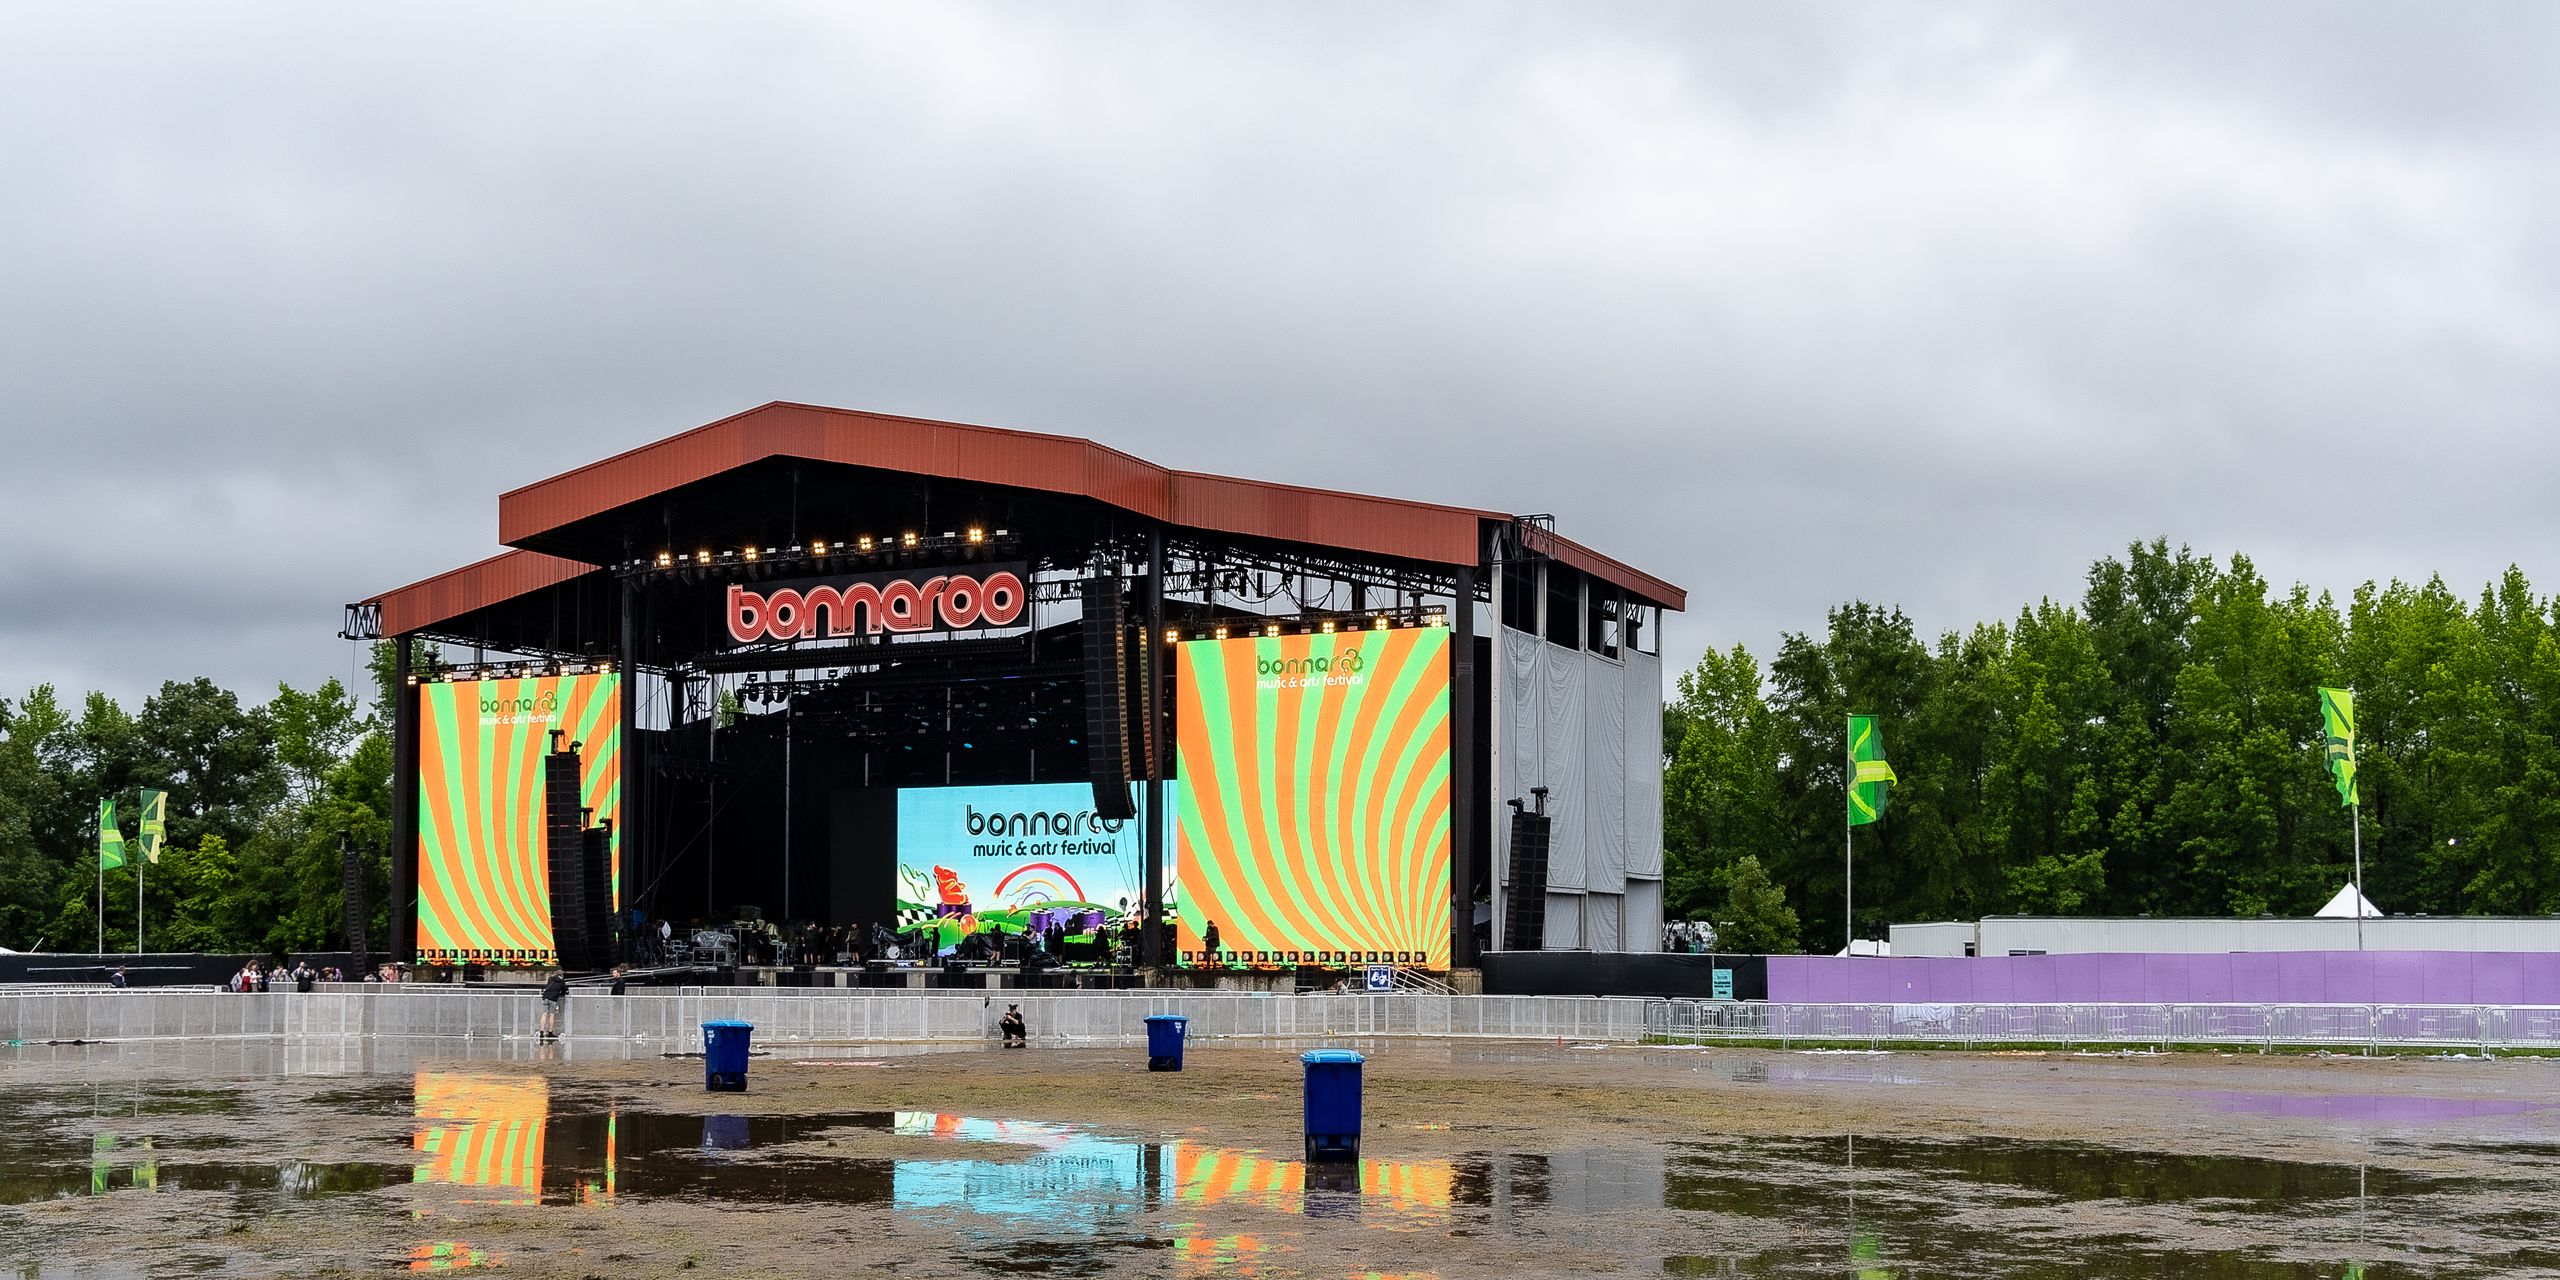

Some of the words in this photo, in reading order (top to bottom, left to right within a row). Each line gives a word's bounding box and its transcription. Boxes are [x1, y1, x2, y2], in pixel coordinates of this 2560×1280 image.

[727, 571, 1024, 643] bonnaroo
[1256, 647, 1364, 675] bonnaroo
[1257, 676, 1287, 689] music
[1288, 677, 1297, 688] &
[1299, 676, 1320, 688] arts
[1323, 674, 1363, 686] festival
[502, 714, 510, 725] &
[527, 712, 556, 723] festival
[973, 840, 1012, 856] music
[1015, 841, 1027, 856] &
[1030, 841, 1058, 856] arts
[1061, 838, 1116, 855] festival
